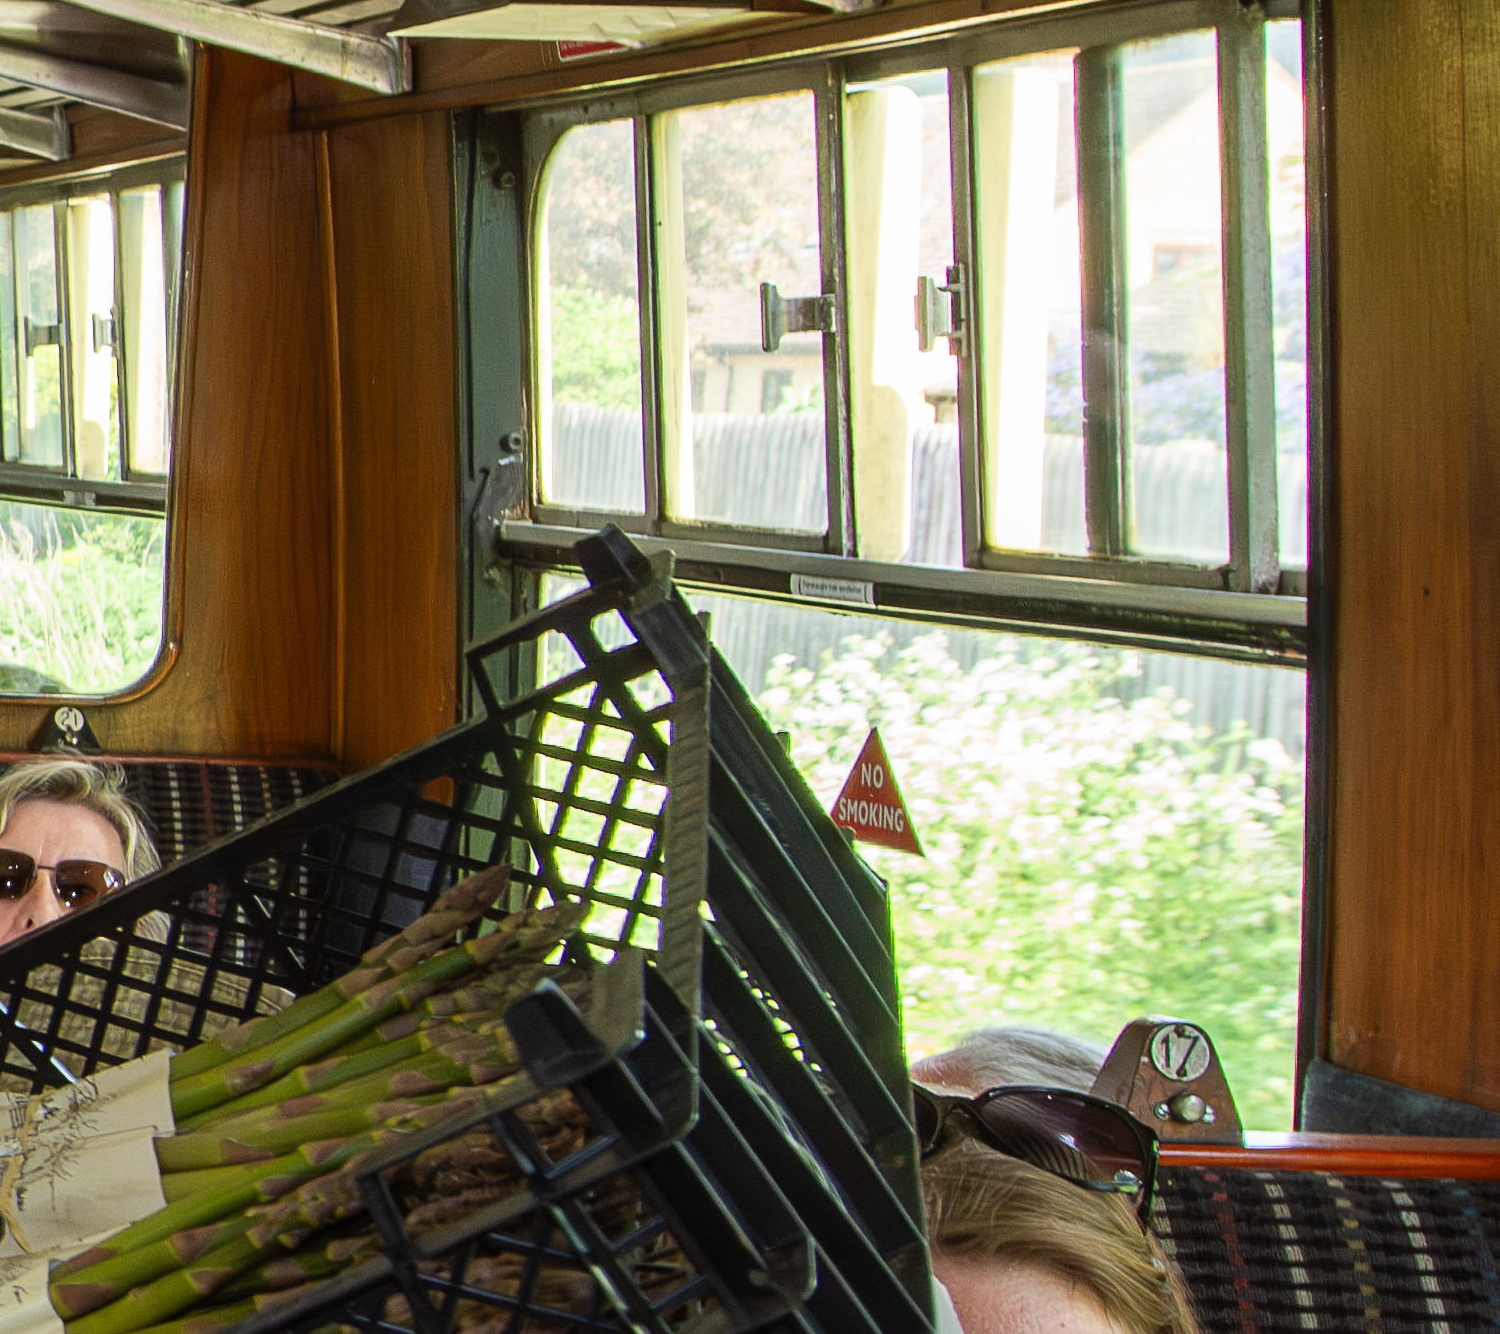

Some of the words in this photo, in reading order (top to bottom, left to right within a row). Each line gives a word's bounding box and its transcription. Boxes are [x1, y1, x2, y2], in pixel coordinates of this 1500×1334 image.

[61, 710, 78, 727] 21
[861, 762, 884, 789] NO
[838, 797, 905, 833] SMOKING
[1160, 1033, 1201, 1077] 17
